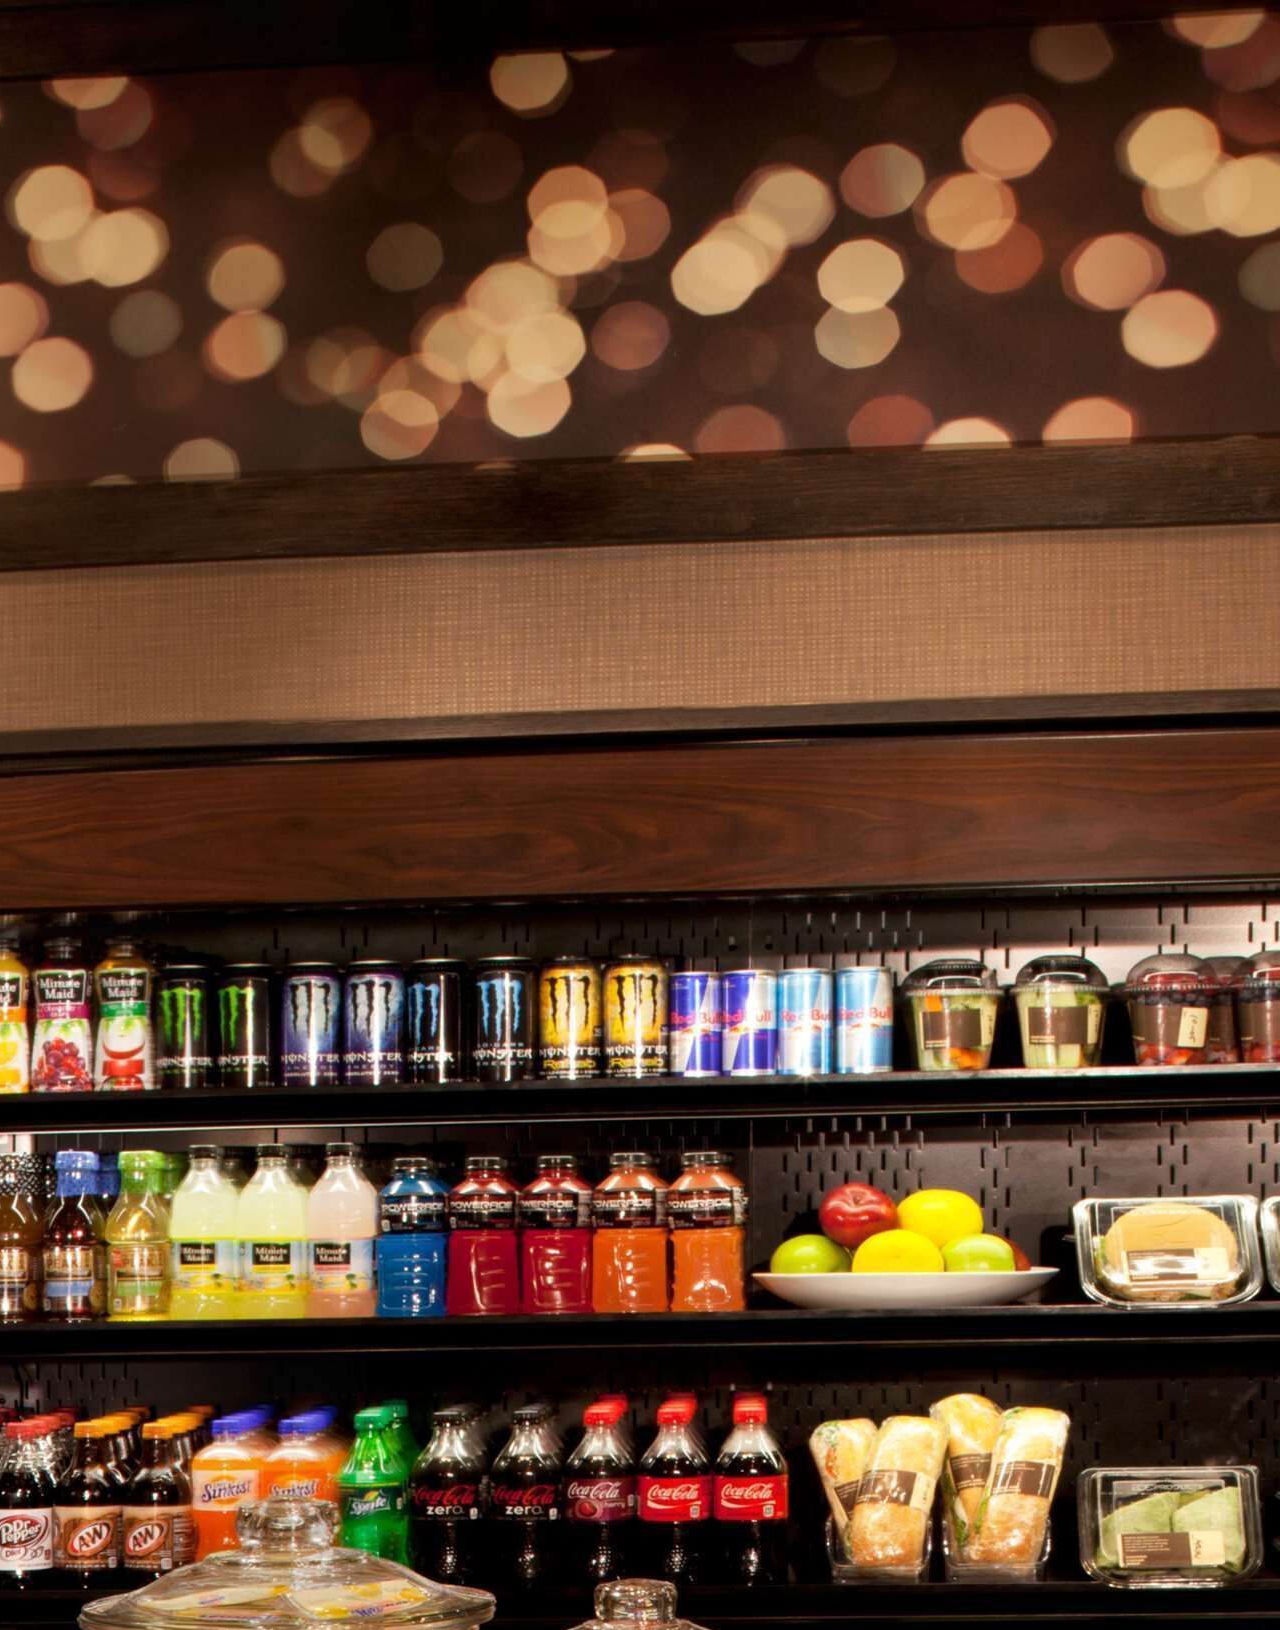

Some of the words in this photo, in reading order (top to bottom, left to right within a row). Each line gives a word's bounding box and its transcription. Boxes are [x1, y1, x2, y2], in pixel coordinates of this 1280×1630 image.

[40, 978, 82, 990] Minute
[44, 988, 75, 1001] Maid
[539, 1046, 601, 1060] MONSTER
[605, 1045, 669, 1058] MONSTER
[381, 1201, 444, 1213] POWERADE
[201, 1480, 252, 1503] Sunkist
[415, 1484, 474, 1506] Coca-Cola
[567, 1481, 621, 1499] Coca-Cola
[647, 1482, 701, 1500] Coca-Cola
[720, 1482, 774, 1500] Coca-Cola
[350, 1498, 389, 1516] Sprite
[425, 1505, 466, 1516] zero
[504, 1504, 542, 1516] zero
[12, 1516, 32, 1531] Dr
